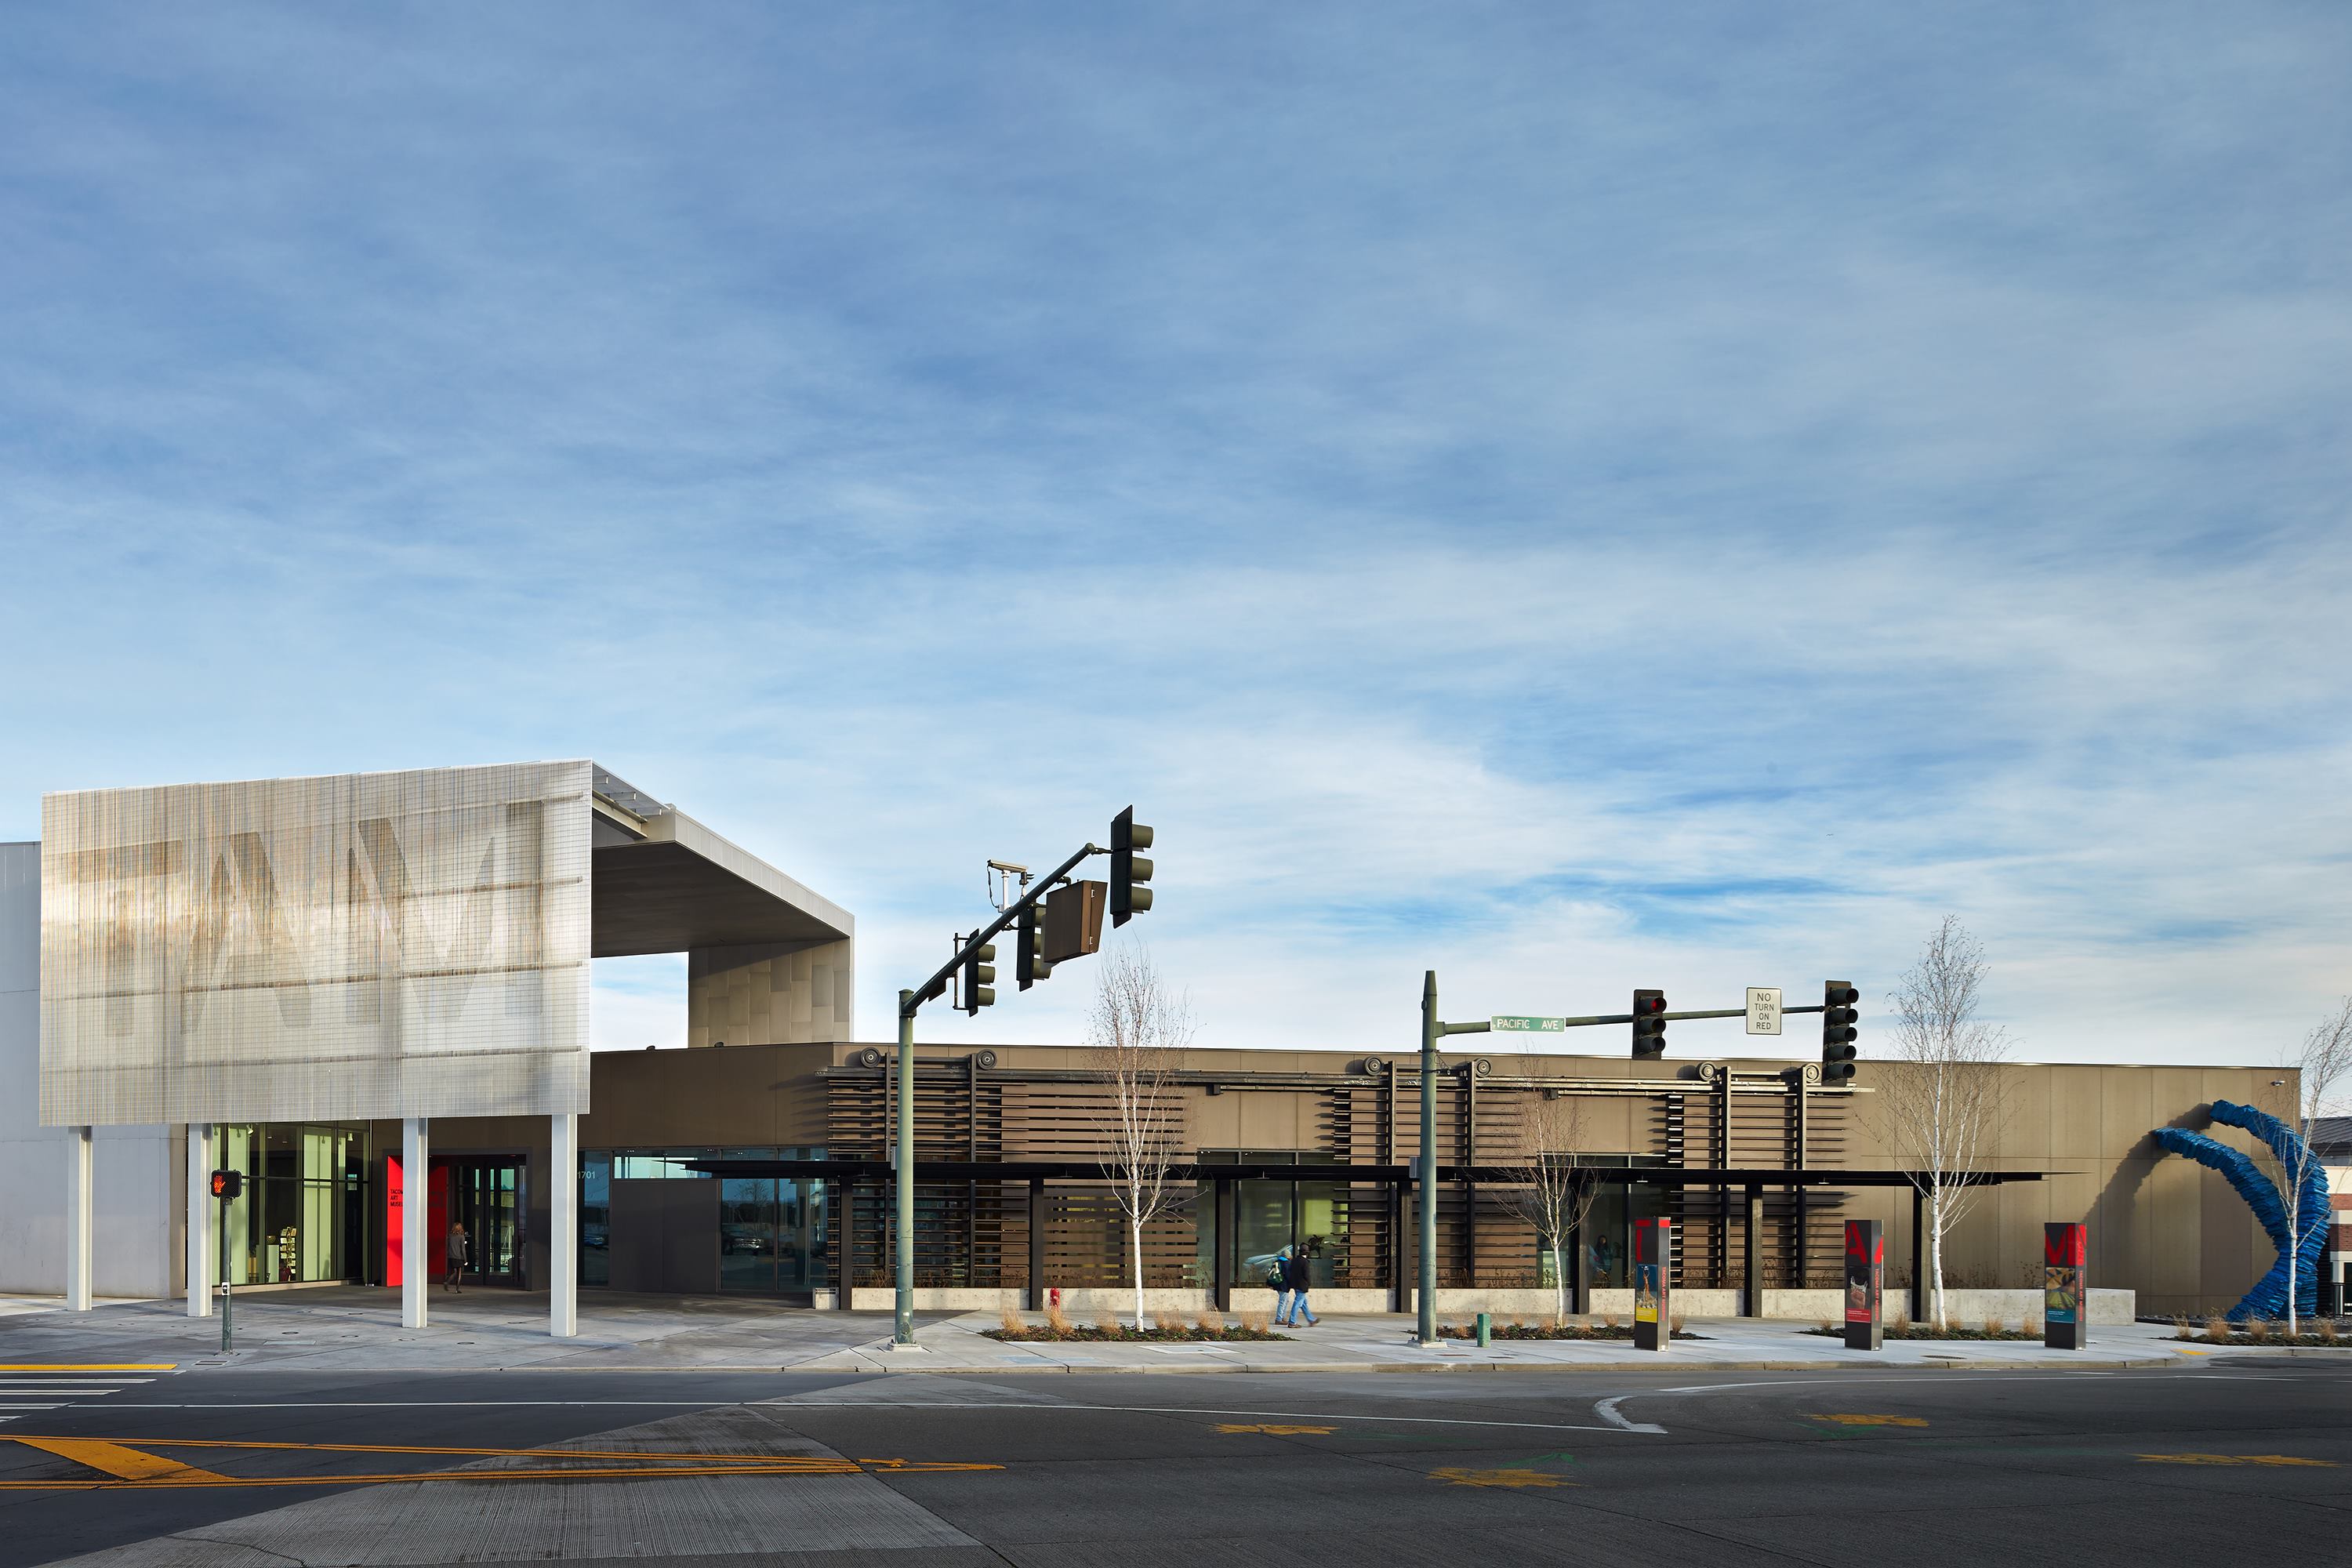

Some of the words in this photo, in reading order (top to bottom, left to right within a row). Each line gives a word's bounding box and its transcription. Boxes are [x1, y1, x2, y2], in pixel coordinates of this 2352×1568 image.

[1757, 993, 1771, 1002] NO
[1754, 1003, 1774, 1011] TURN
[1759, 1012, 1769, 1021] ON
[1497, 1018, 1530, 1029] PACIFIC
[1541, 1020, 1559, 1030] AVE
[1756, 1022, 1772, 1030] RED
[577, 1171, 596, 1179] 1701
